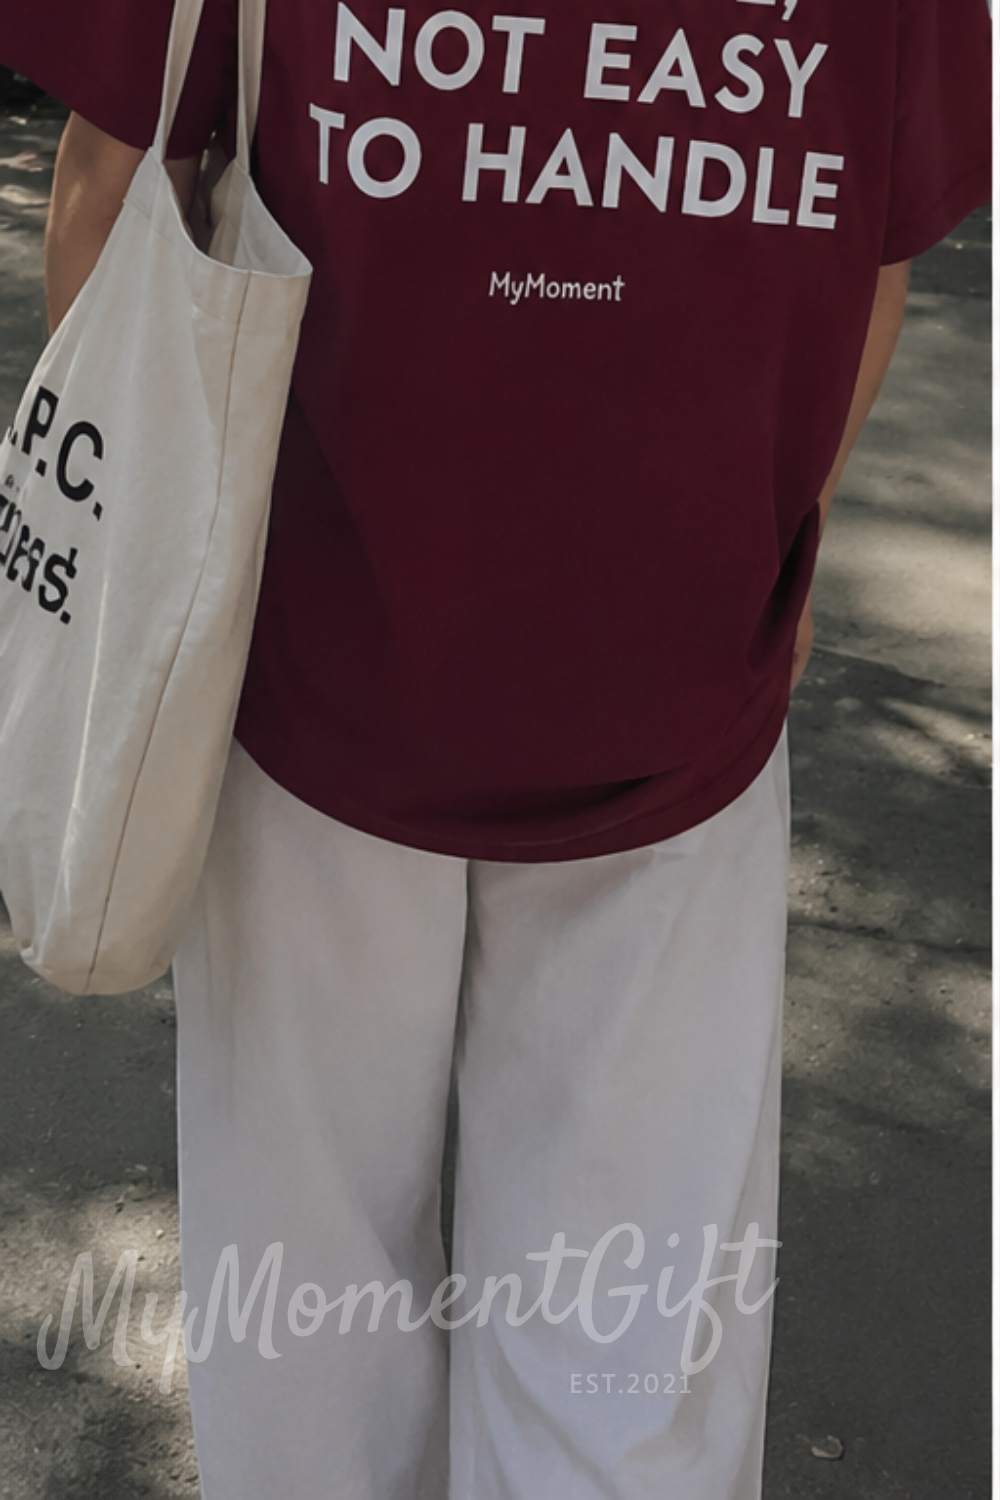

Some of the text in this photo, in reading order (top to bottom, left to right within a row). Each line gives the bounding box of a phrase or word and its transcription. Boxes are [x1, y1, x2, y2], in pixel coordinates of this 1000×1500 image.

[333, 1, 828, 118] NOT EASY
[308, 103, 844, 229] TO HANDLE
[488, 271, 625, 305] MyMoment
